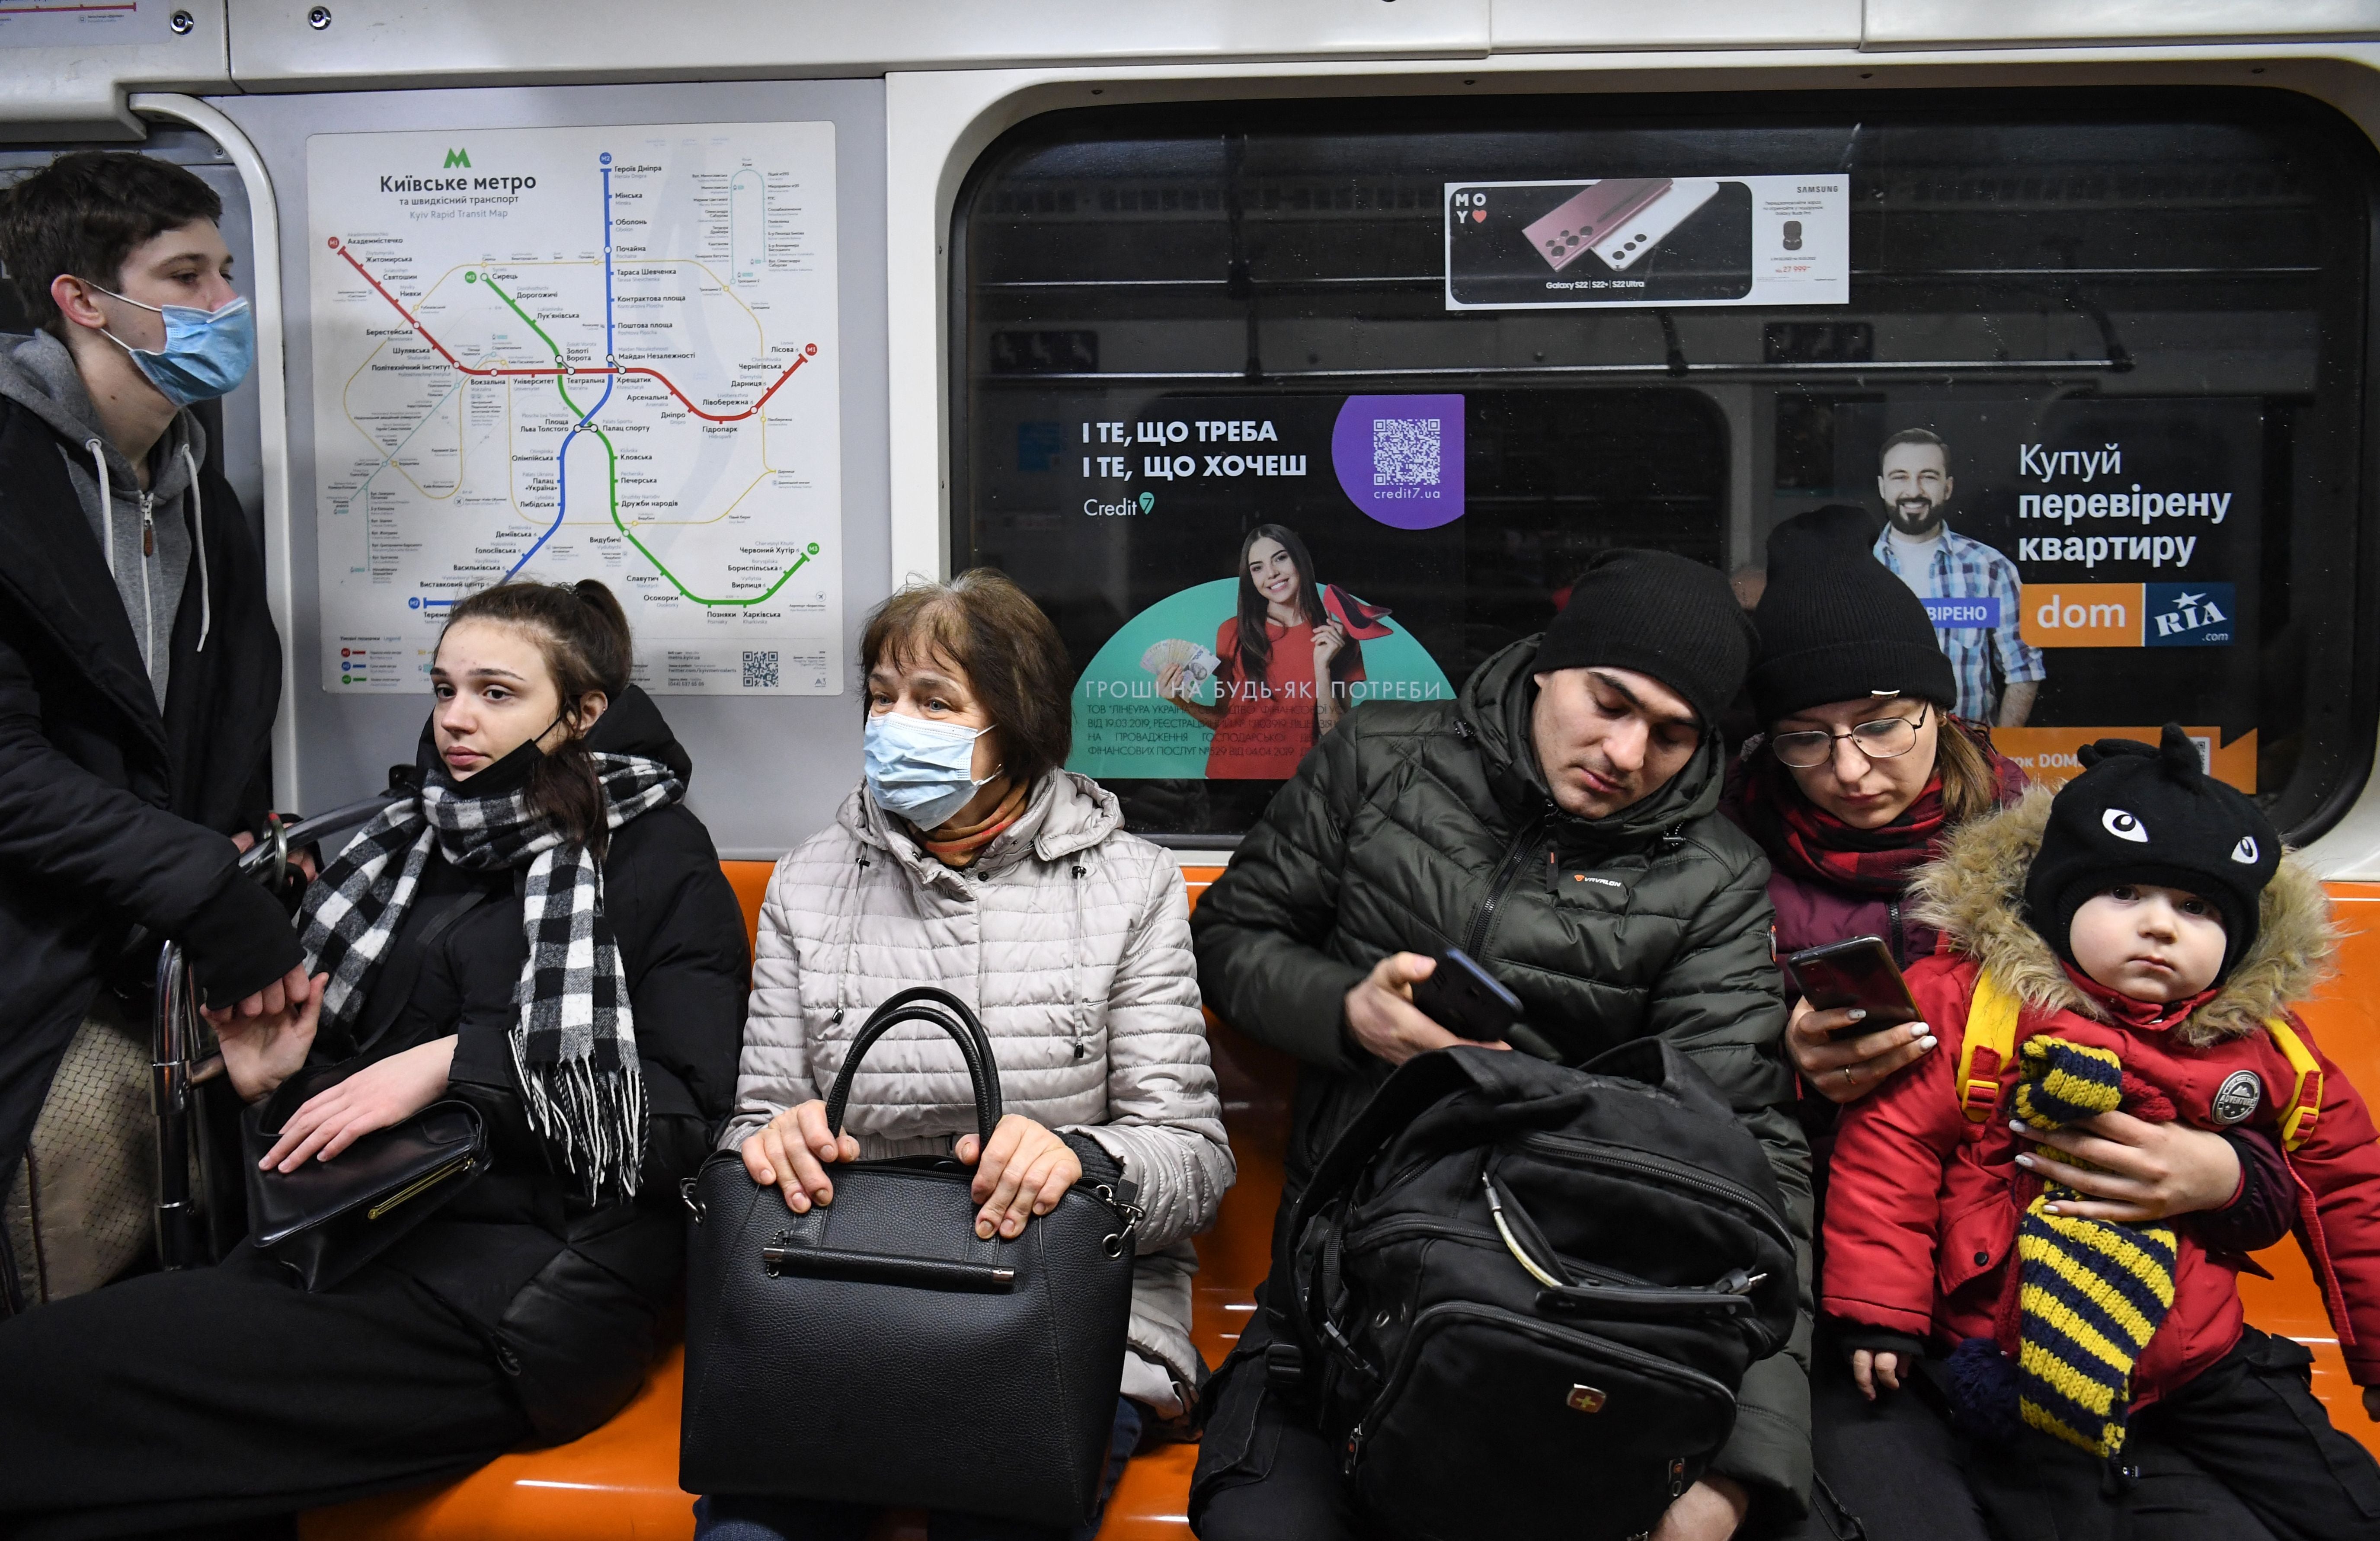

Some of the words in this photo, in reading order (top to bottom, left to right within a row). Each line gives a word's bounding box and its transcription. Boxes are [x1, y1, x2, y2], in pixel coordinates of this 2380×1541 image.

[381, 175, 467, 192] Київське
[474, 176, 537, 195] метро
[411, 196, 467, 207] швидкісний
[470, 195, 519, 206] транспорт
[410, 210, 429, 220] Kyiv
[431, 210, 456, 220] Rapid
[458, 209, 486, 218] Transit
[489, 209, 508, 218] Map
[1545, 282, 1575, 290] Galaxy
[366, 329, 413, 337] Берестейська
[1096, 422, 1133, 448] ТЕ,
[1137, 421, 1189, 448] ЩО
[1195, 420, 1278, 442] ТРЕБА
[1096, 456, 1133, 481] ТЕ,
[1144, 455, 1196, 481] ЩО
[1202, 454, 1307, 477] ХОЧЕШ
[2019, 443, 2122, 483] Купуй
[1373, 488, 1440, 499] credit7.ua
[2019, 484, 2233, 526] перевірену
[2019, 535, 2197, 568] квартиру
[1926, 606, 1987, 621] ВІРЕНО
[2036, 594, 2126, 629] dom
[2153, 601, 2227, 637] RIA
[2201, 633, 2229, 641] .com
[1086, 681, 1159, 699] ГРОШІ
[1171, 681, 1203, 699] НА
[1214, 681, 1319, 702] БУДЬ-ЯКІ
[1331, 681, 1440, 699] ПОТРЕБИ
[1088, 705, 1106, 714] ТОВ
[1088, 719, 1103, 729] ВІД
[1105, 719, 1152, 729] 19.03.2019,
[1088, 733, 1102, 741] НА
[1115, 732, 1188, 742] ПРОВАДЖЕННЯ
[1088, 746, 1155, 756] ФІНАНСОВИХ
[1157, 746, 1196, 756] ПОСЛУГ
